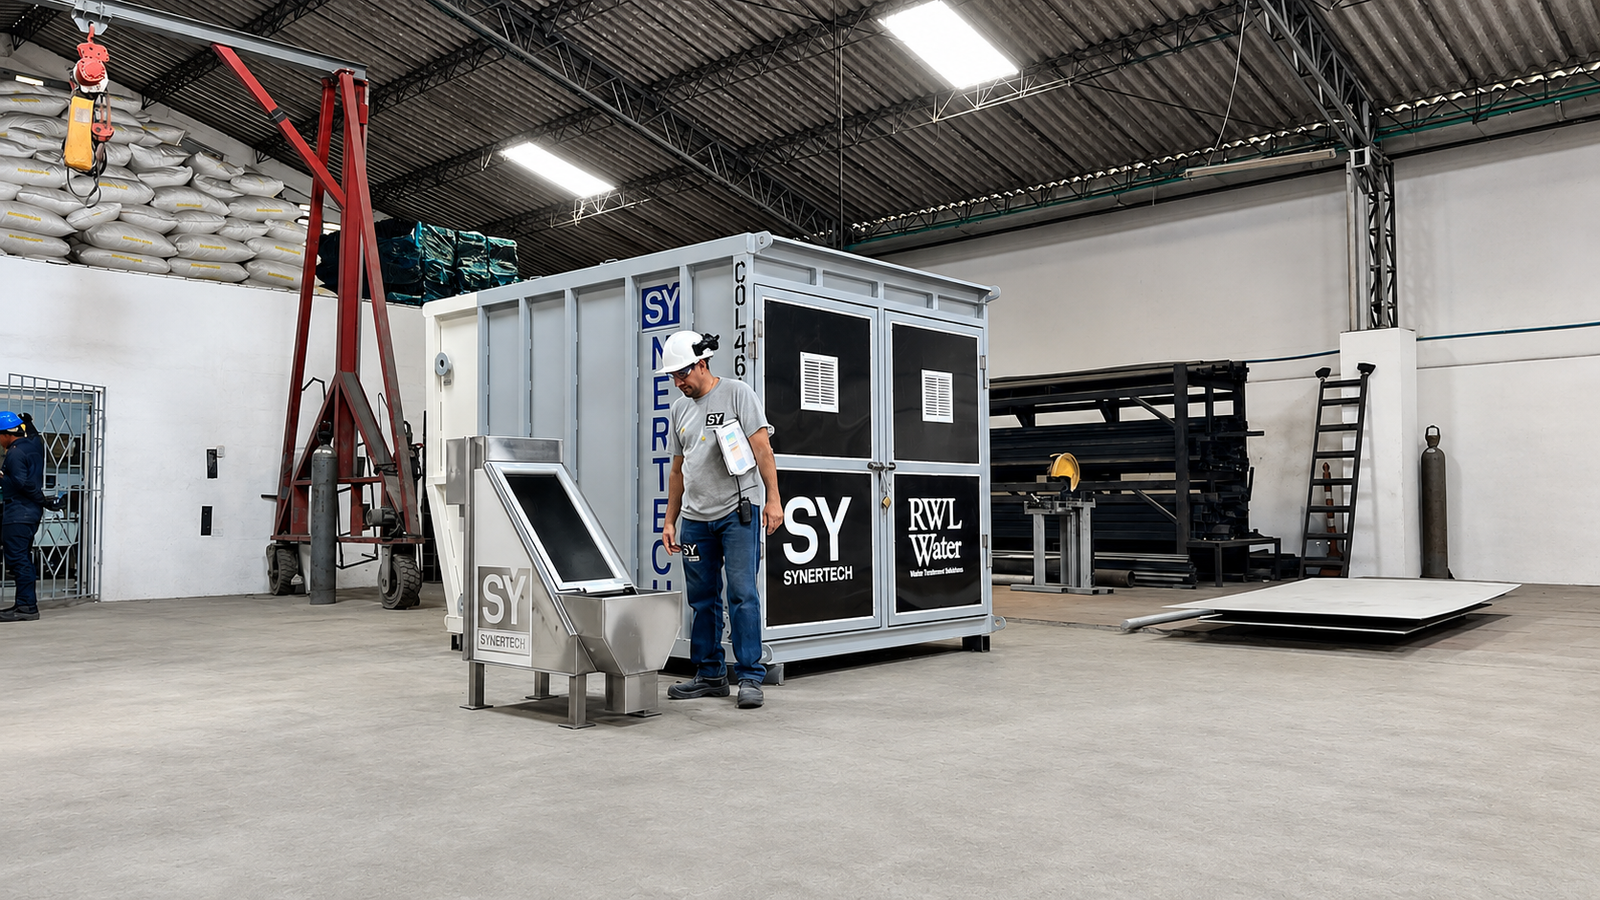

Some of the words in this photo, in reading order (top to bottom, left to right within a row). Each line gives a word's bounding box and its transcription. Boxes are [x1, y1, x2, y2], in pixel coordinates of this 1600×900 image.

[734, 261, 746, 381] COL46
[706, 413, 723, 425] SY
[782, 496, 852, 565] SY
[908, 498, 962, 531] RWL
[908, 533, 962, 567] Water
[783, 566, 853, 586] SYNERTECH
[482, 573, 527, 625] SY
[480, 633, 526, 650] SYNERTECH
